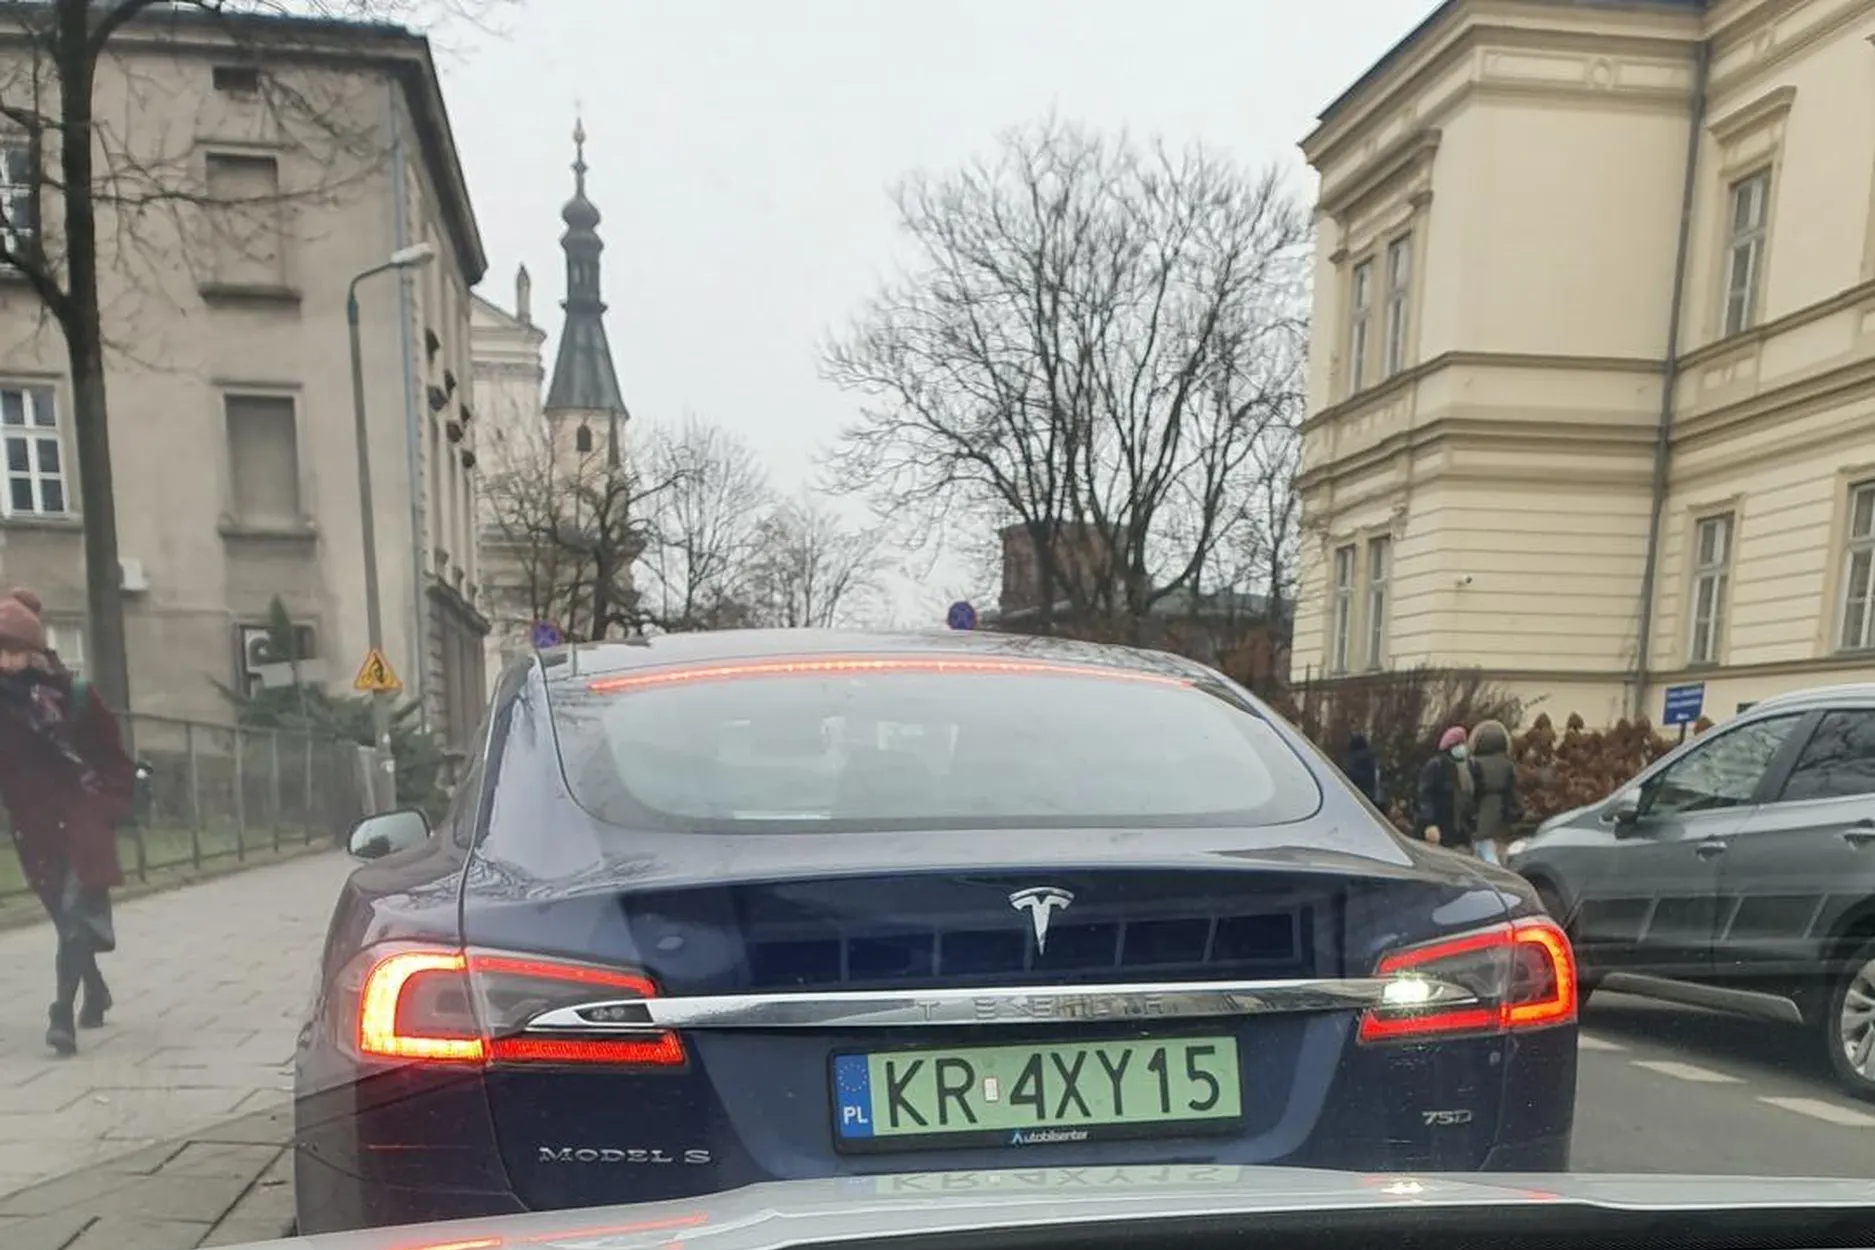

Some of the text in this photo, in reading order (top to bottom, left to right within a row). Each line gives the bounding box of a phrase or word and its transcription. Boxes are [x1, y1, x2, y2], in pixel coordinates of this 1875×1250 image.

[885, 1045, 1220, 1127] KR 4XY15
[843, 1106, 869, 1125] PL
[1421, 1109, 1473, 1126] 75D
[538, 1147, 712, 1165] MODEL S
